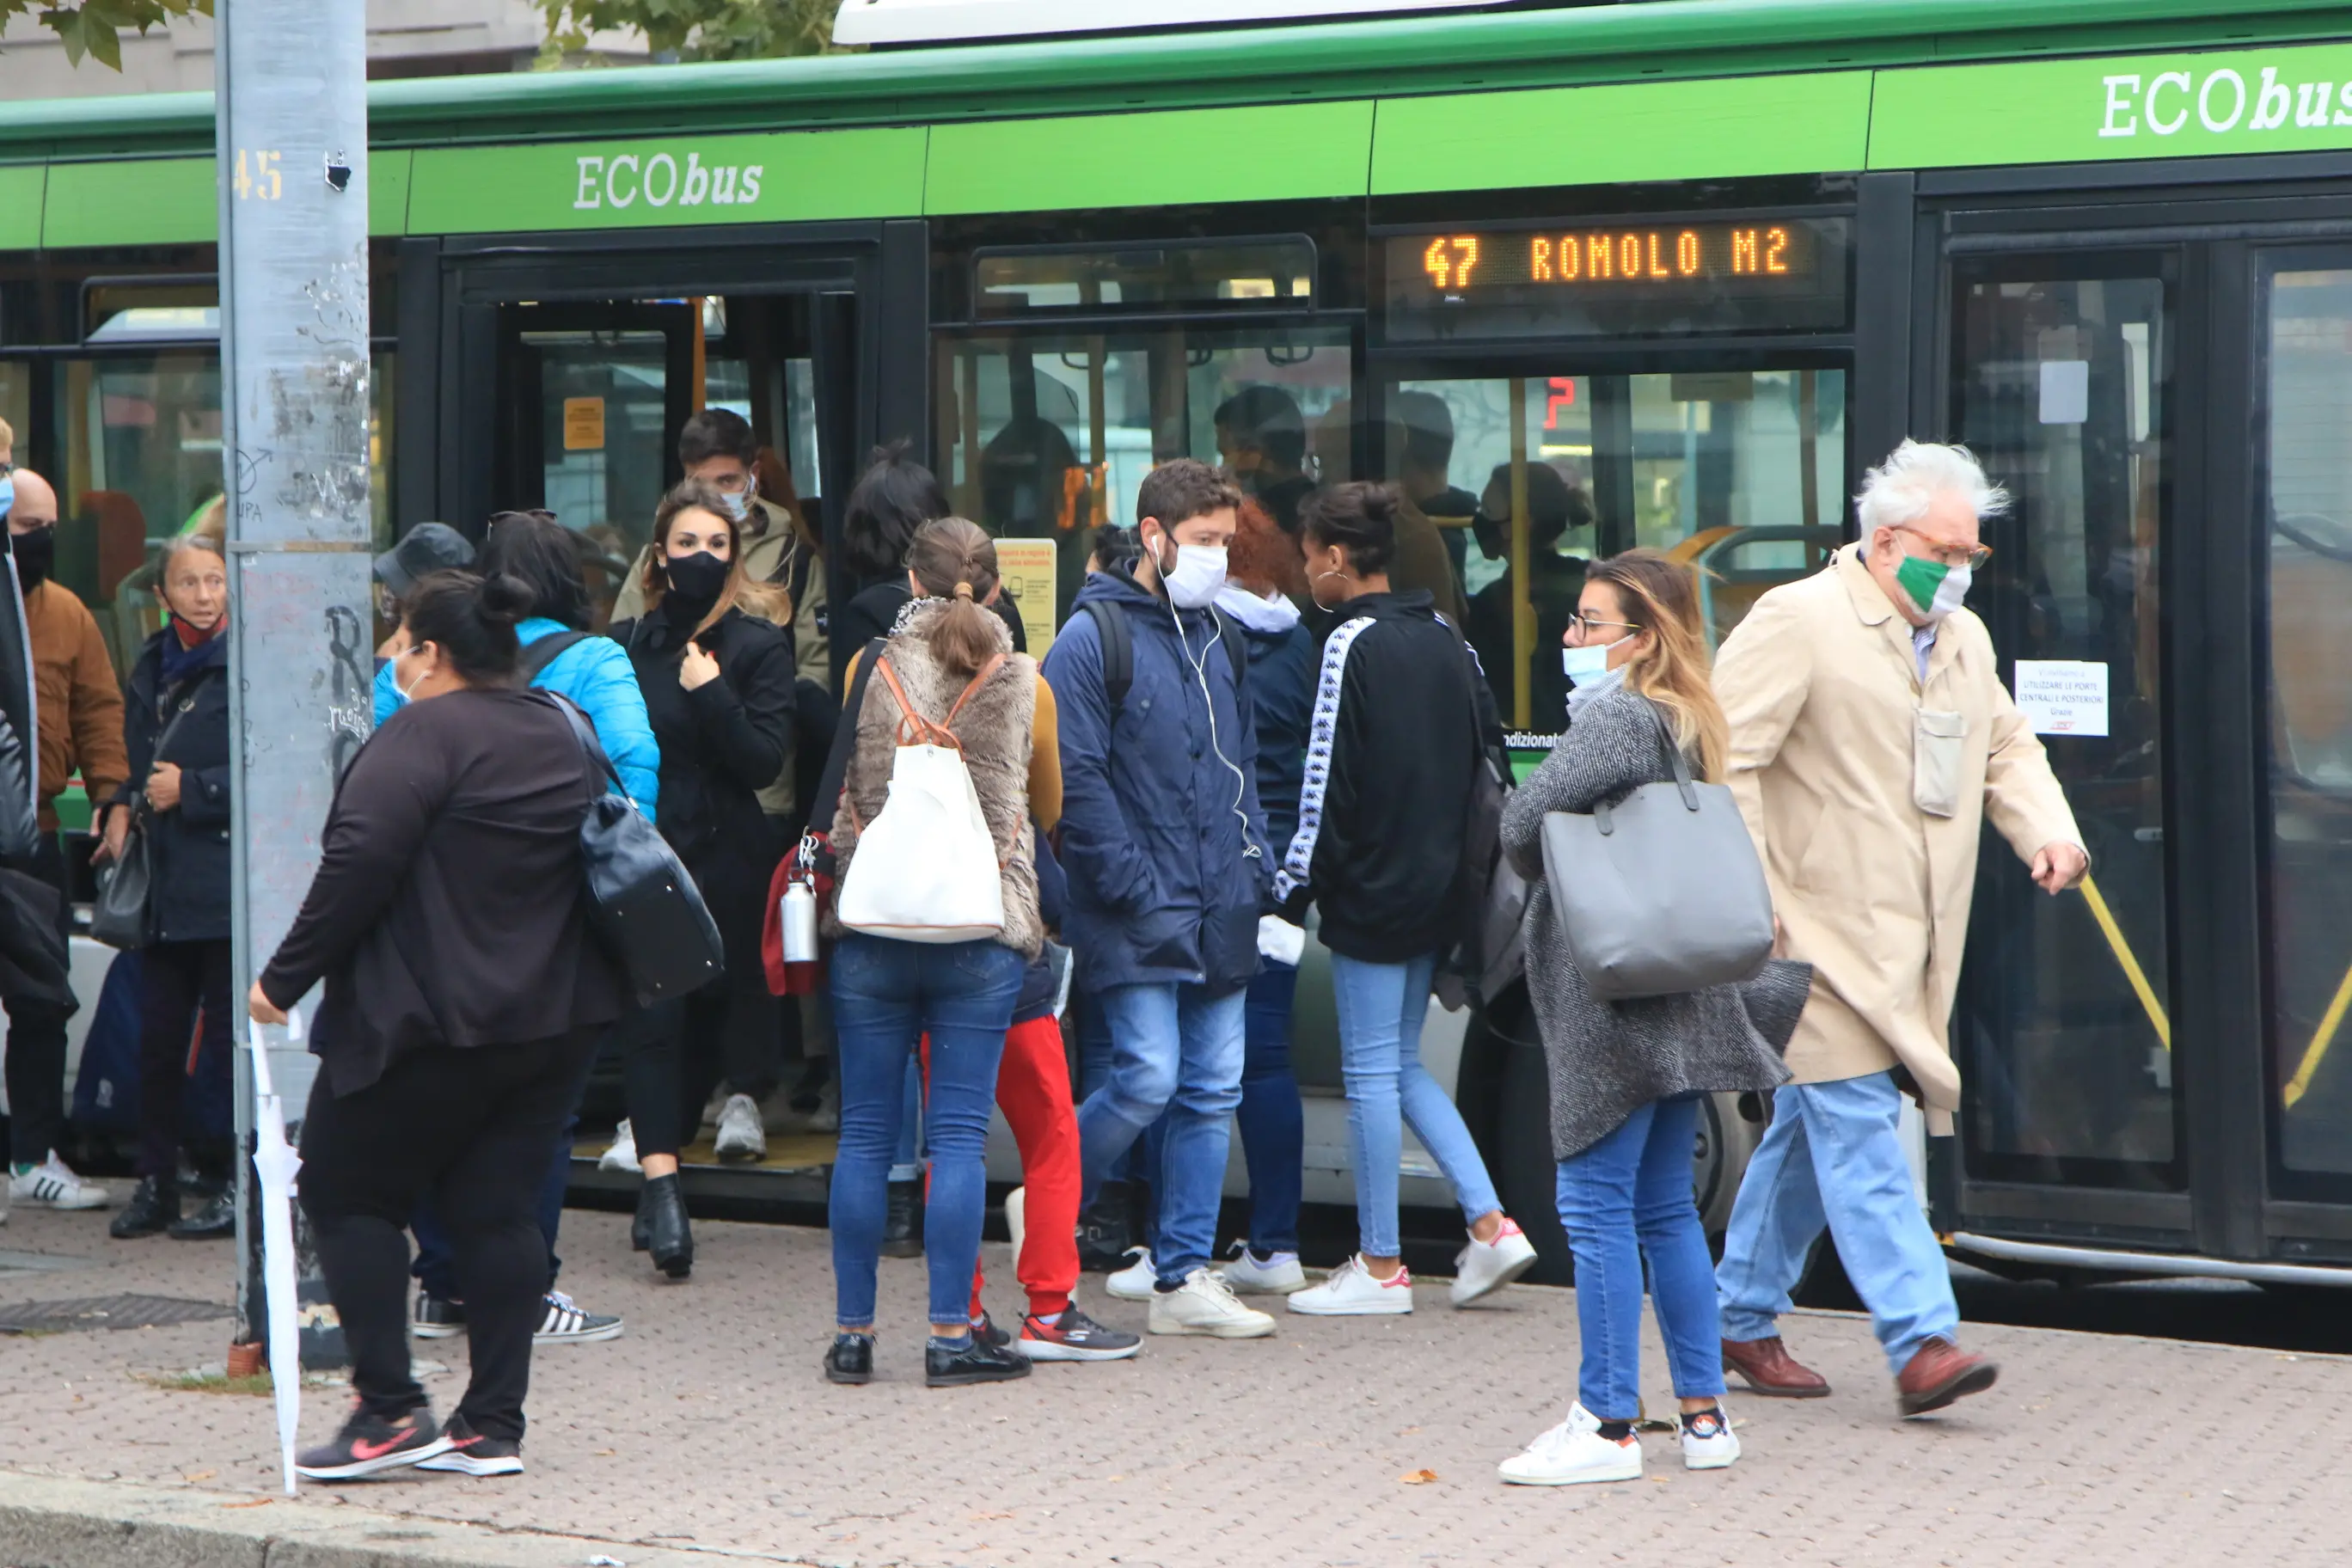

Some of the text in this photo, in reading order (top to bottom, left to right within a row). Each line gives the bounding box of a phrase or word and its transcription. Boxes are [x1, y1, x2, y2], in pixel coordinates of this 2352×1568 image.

[2098, 66, 2352, 138] ECObus
[233, 148, 282, 200] 45
[573, 152, 764, 209] ECObus
[1424, 228, 1787, 287] 47 ROMOLO M2
[2019, 693, 2054, 702] CENTRALI
[2061, 694, 2104, 704] POSTERIORI
[2023, 680, 2063, 689] UTILIZZARE
[2074, 682, 2098, 691] PORTE
[1503, 731, 1561, 747] ndizionat
